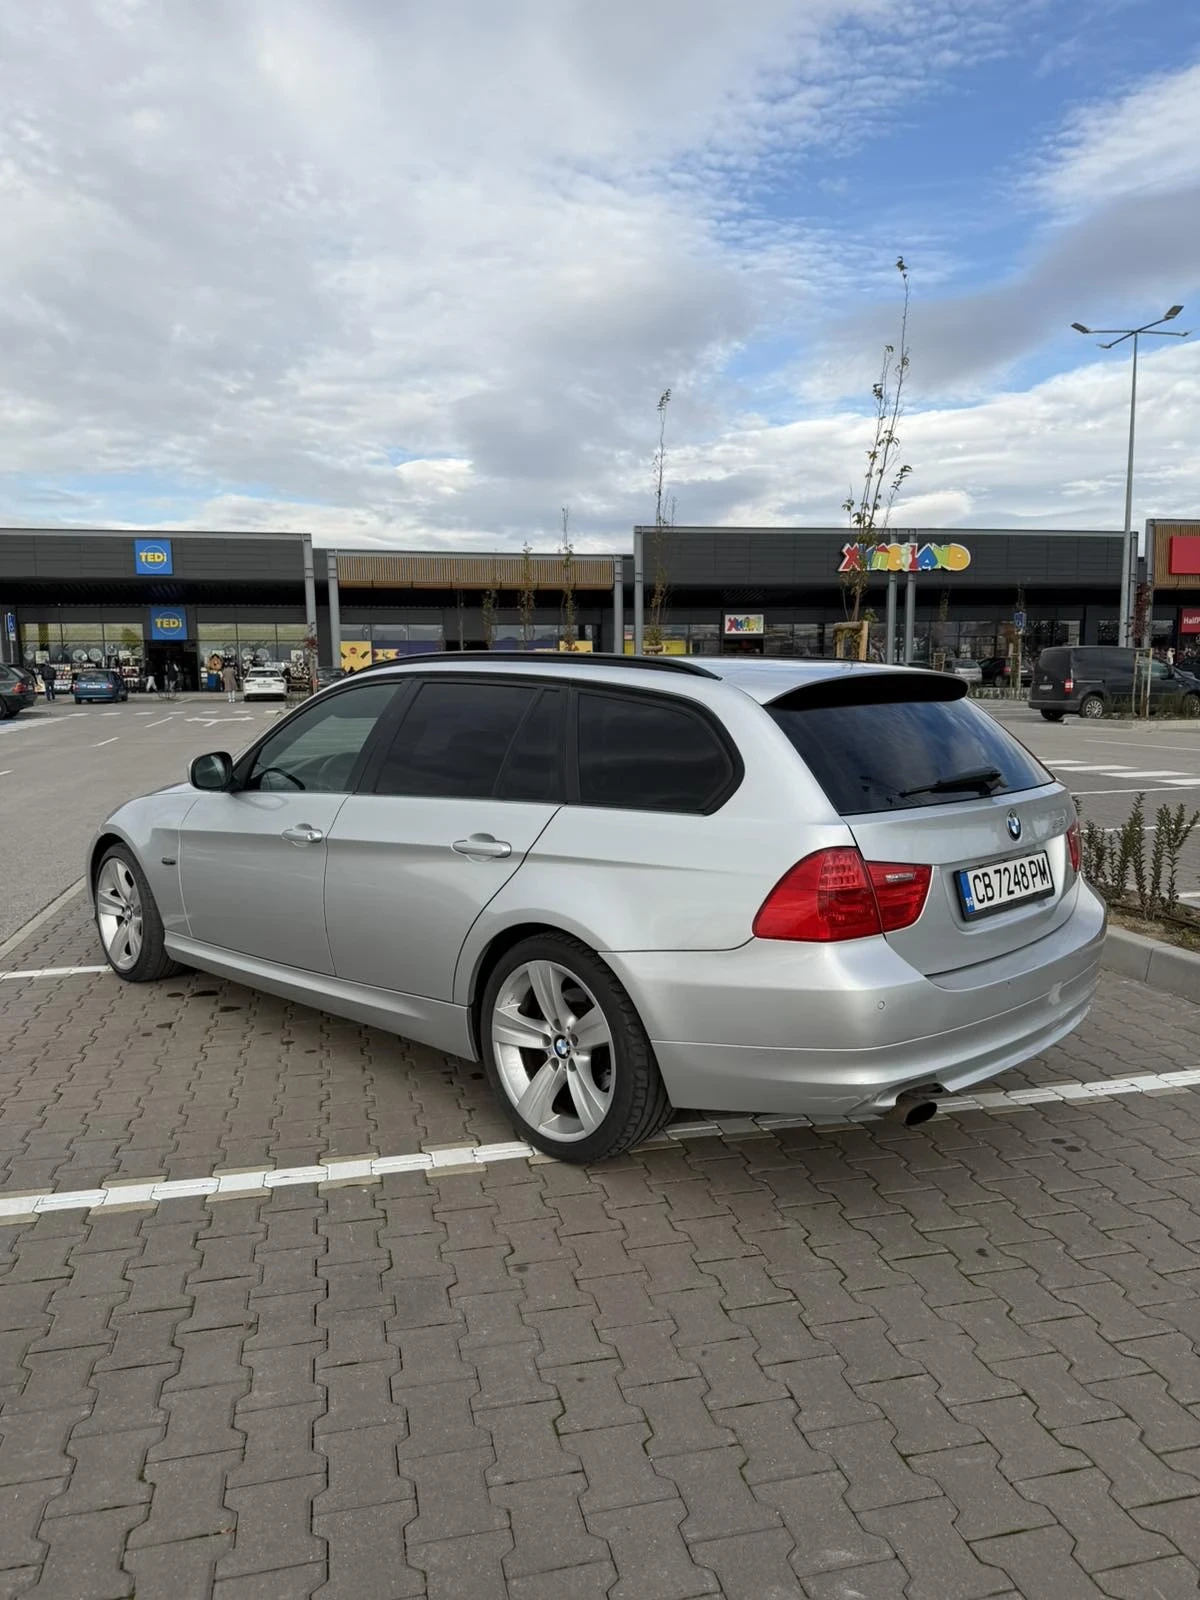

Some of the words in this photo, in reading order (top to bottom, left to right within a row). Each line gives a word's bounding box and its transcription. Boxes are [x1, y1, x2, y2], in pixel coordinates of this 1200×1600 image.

[140, 552, 167, 562] TEDi
[155, 618, 182, 628] TEDi
[993, 862, 1030, 899] 7248
